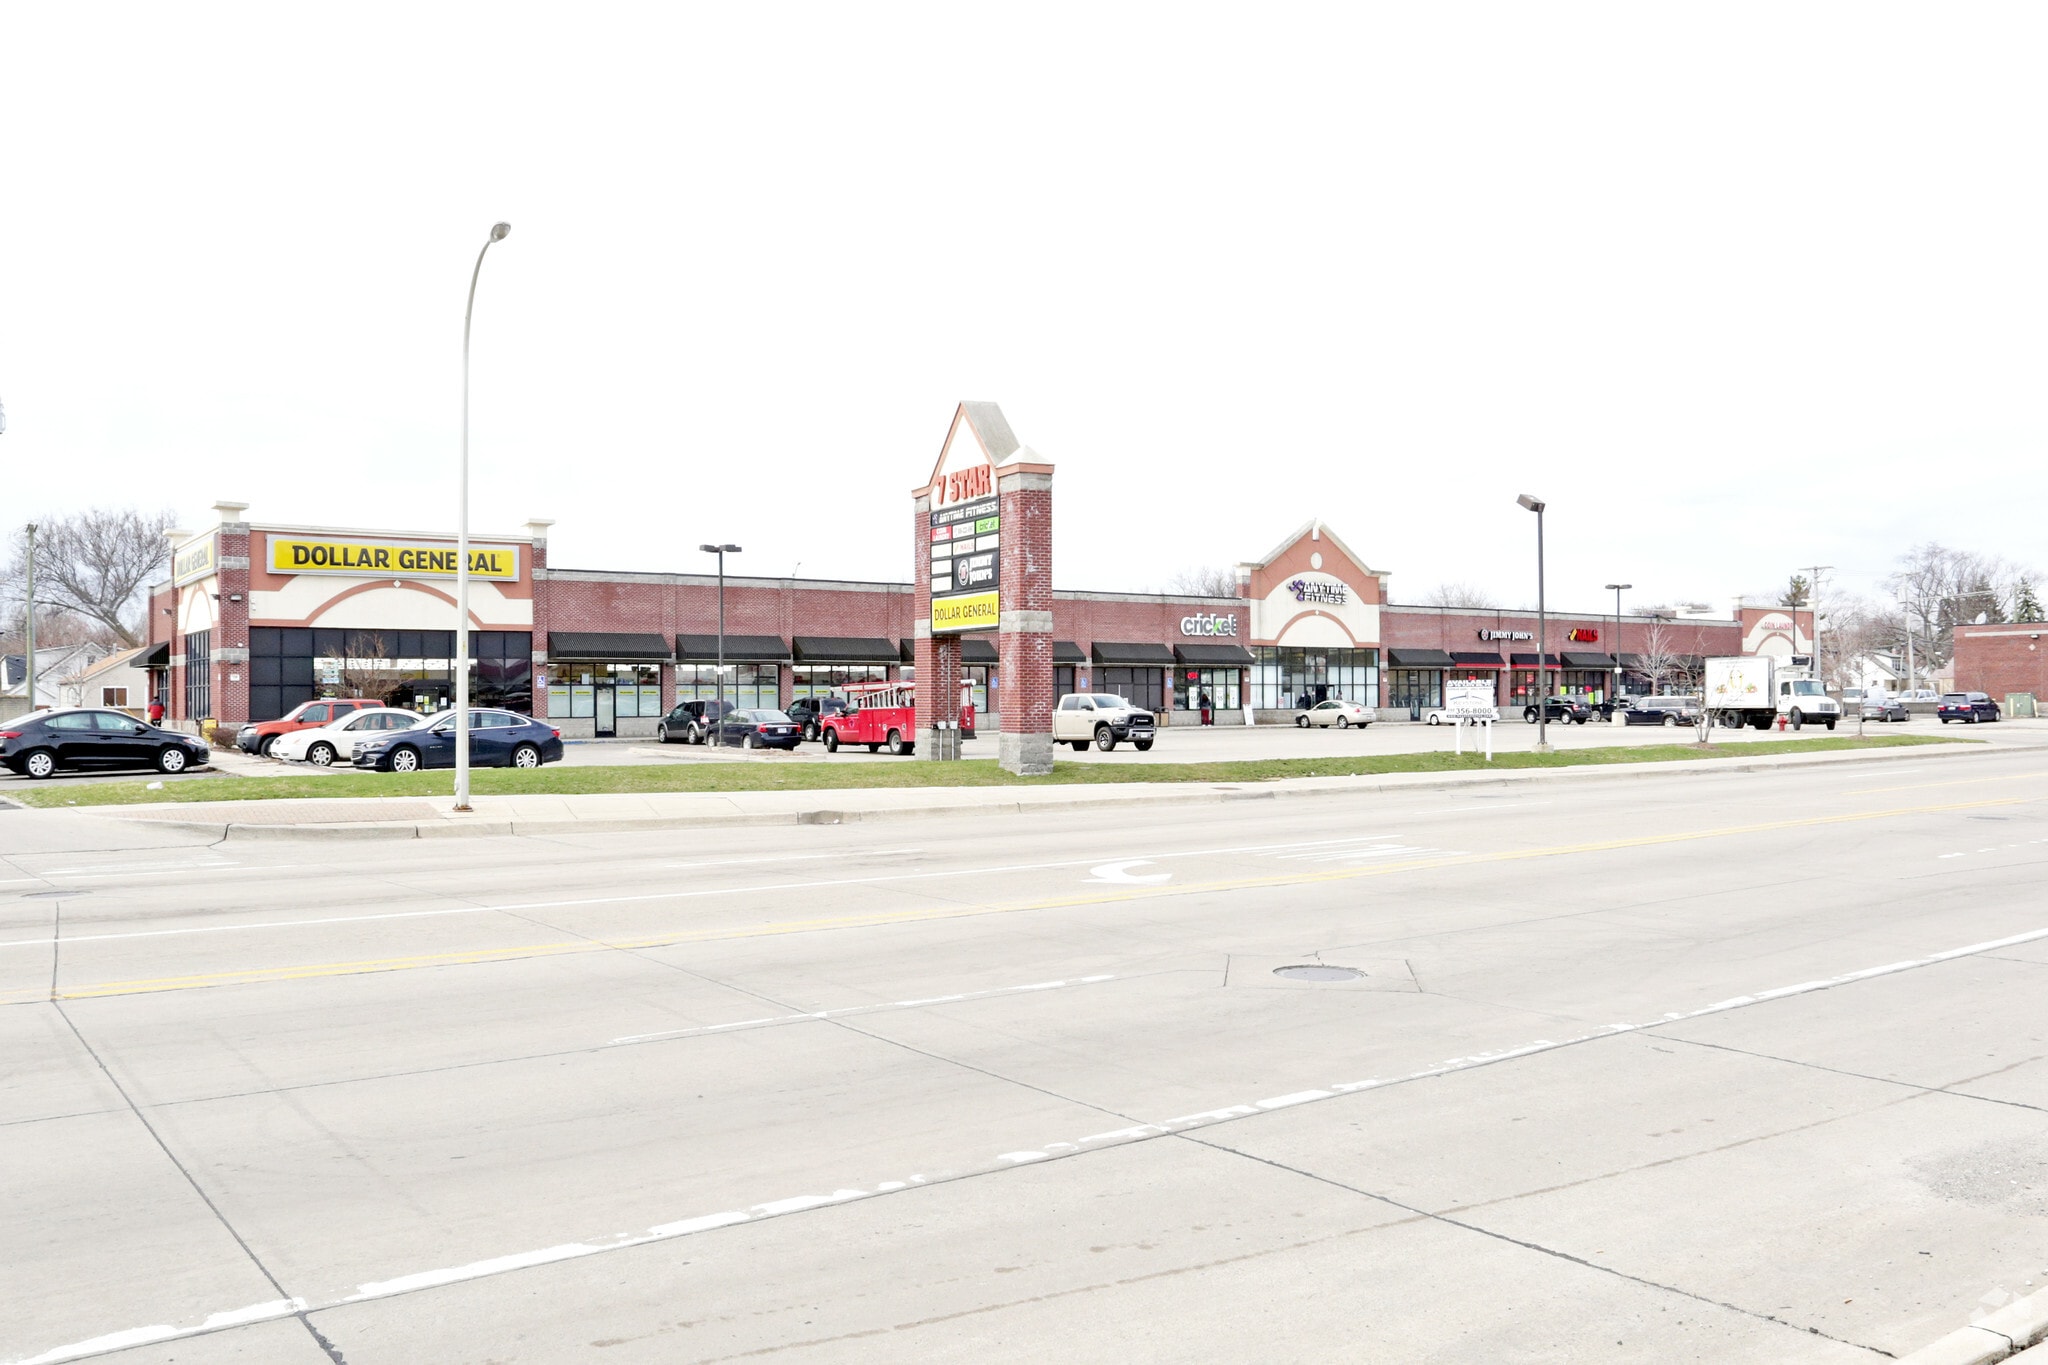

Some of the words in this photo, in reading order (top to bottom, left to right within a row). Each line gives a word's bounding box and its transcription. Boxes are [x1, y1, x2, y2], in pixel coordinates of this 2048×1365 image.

[935, 475, 946, 505] 7
[949, 464, 991, 502] STAR
[965, 501, 996, 518] FITNESS
[292, 545, 390, 568] DOLLAR
[1303, 582, 1348, 594] ANYTIME
[1304, 592, 1348, 604] FITNESS
[934, 606, 961, 621] DOLLAR
[962, 603, 996, 618] GENERAL
[1181, 613, 1237, 636] cricket
[1490, 629, 1511, 640] JIMMY
[1512, 630, 1533, 641] JOHN'S
[1576, 628, 1598, 642] NAILS
[1446, 679, 1492, 687] AVAILABLE
[1456, 707, 1492, 715] 356-8000
